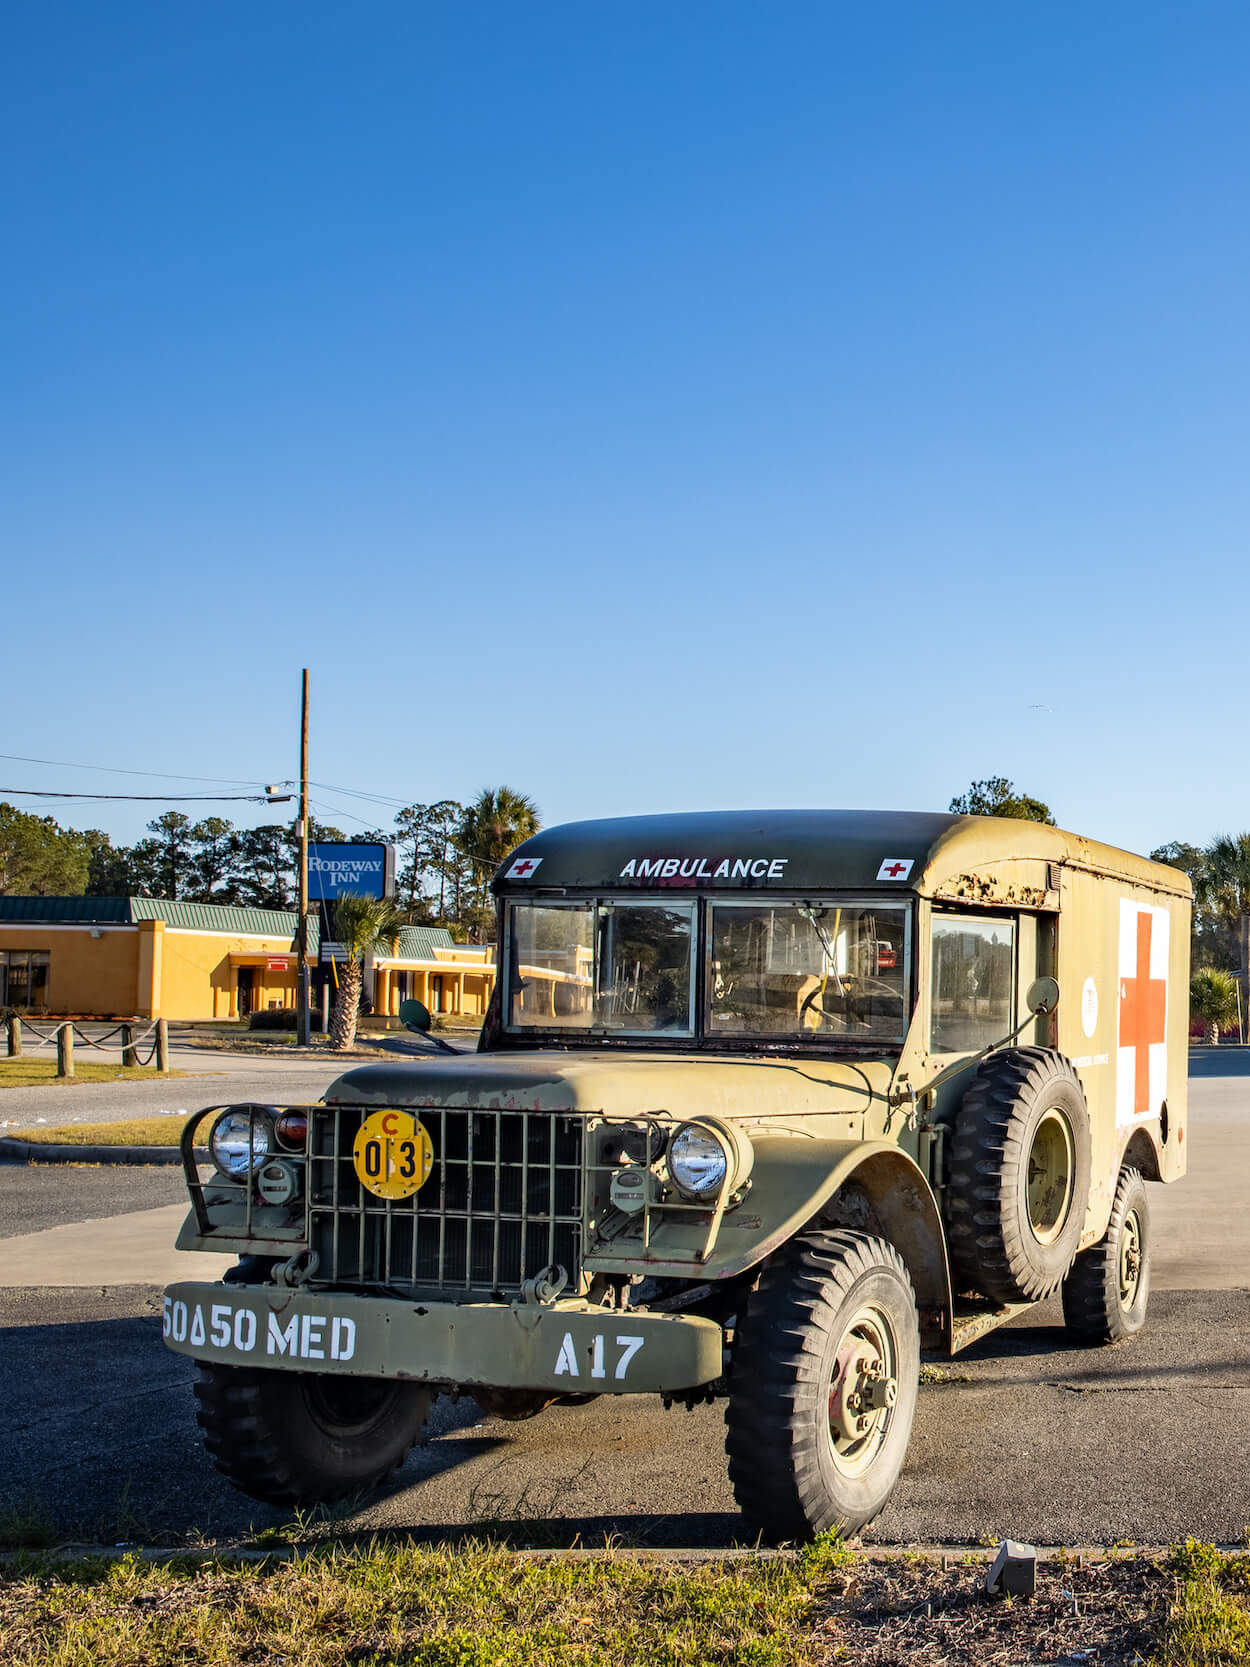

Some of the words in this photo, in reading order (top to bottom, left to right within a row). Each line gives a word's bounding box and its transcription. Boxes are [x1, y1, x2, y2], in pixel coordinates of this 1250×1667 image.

[619, 858, 788, 878] AMBULANCE
[382, 1113, 399, 1135] C
[266, 1311, 356, 1361] MED
